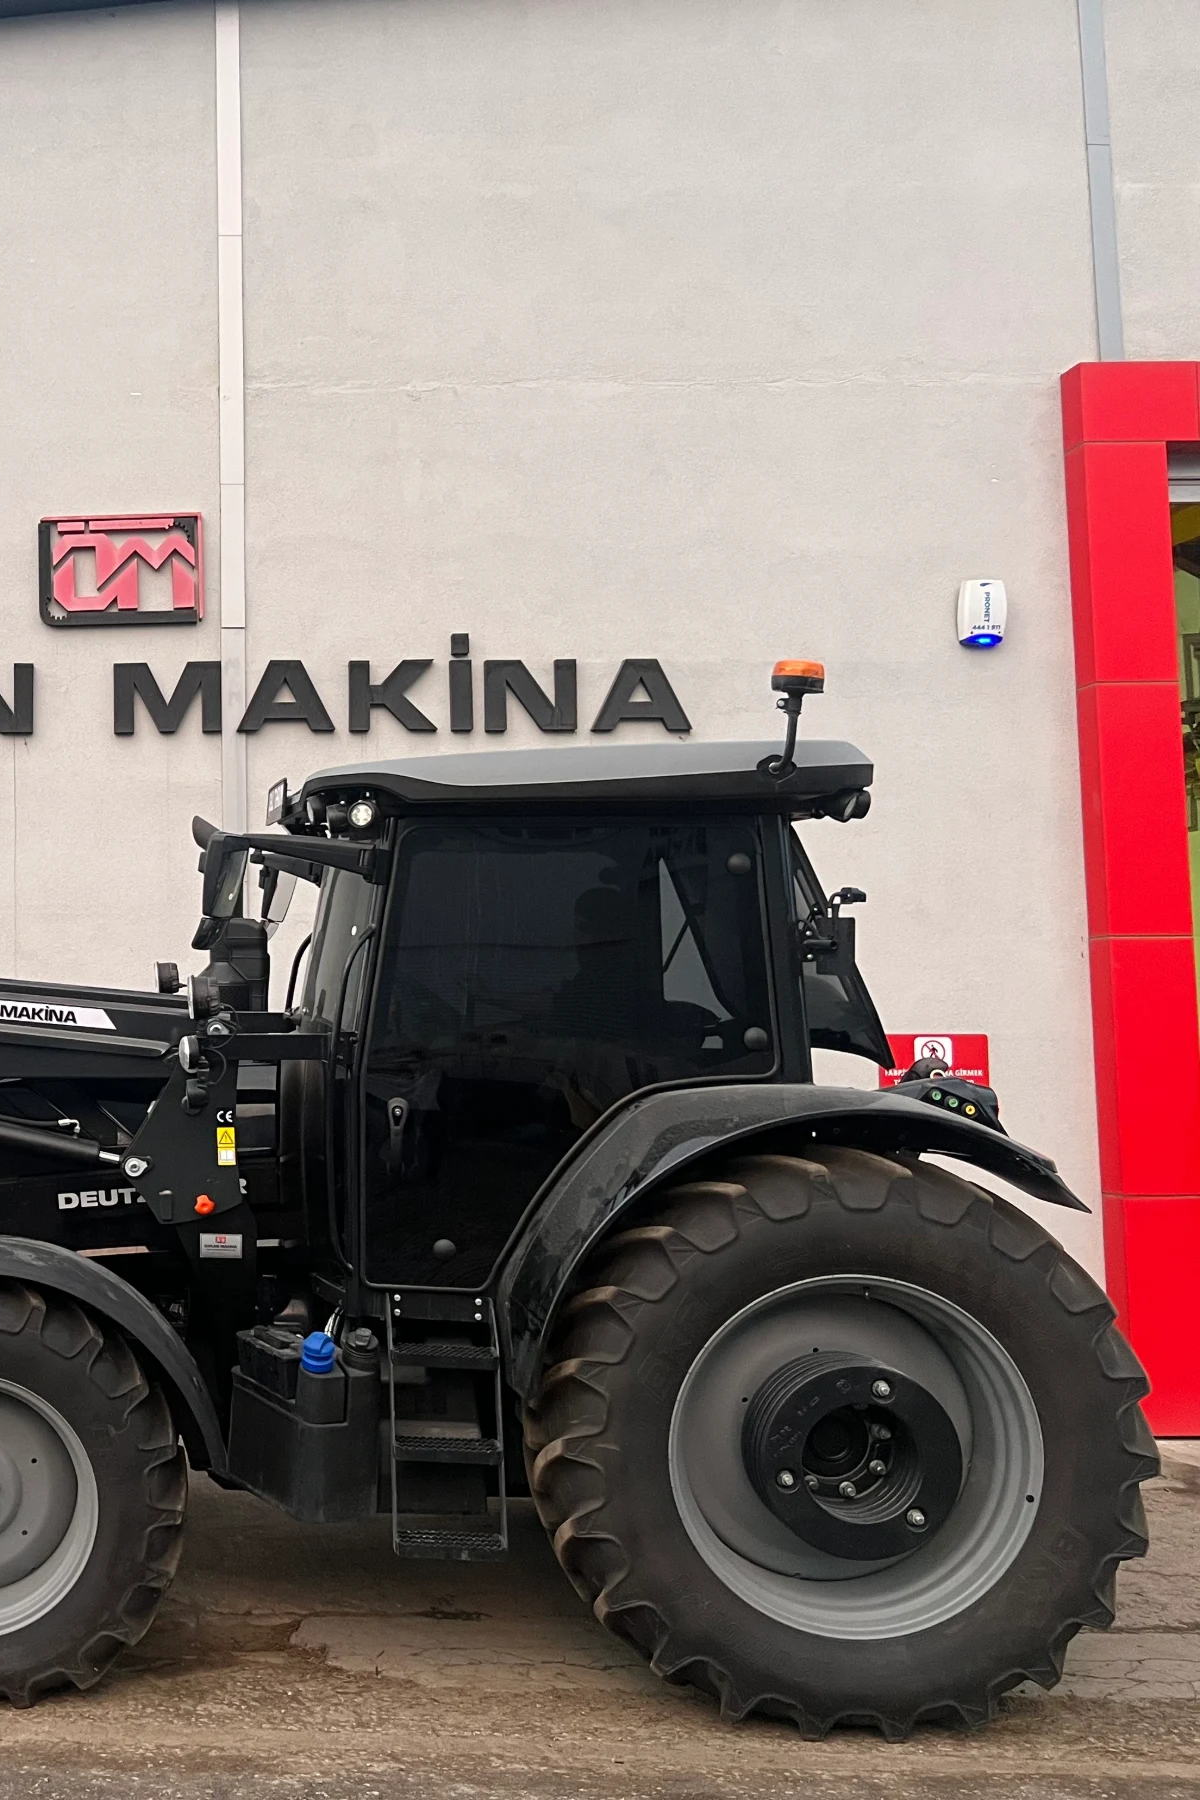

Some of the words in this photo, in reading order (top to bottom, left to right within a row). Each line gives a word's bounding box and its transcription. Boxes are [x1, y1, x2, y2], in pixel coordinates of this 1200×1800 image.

[113, 633, 693, 735] MAKİNA
[0, 1005, 78, 1024] MAKİNA
[954, 1068, 983, 1077] GİRMEK
[216, 1110, 233, 1123] CE
